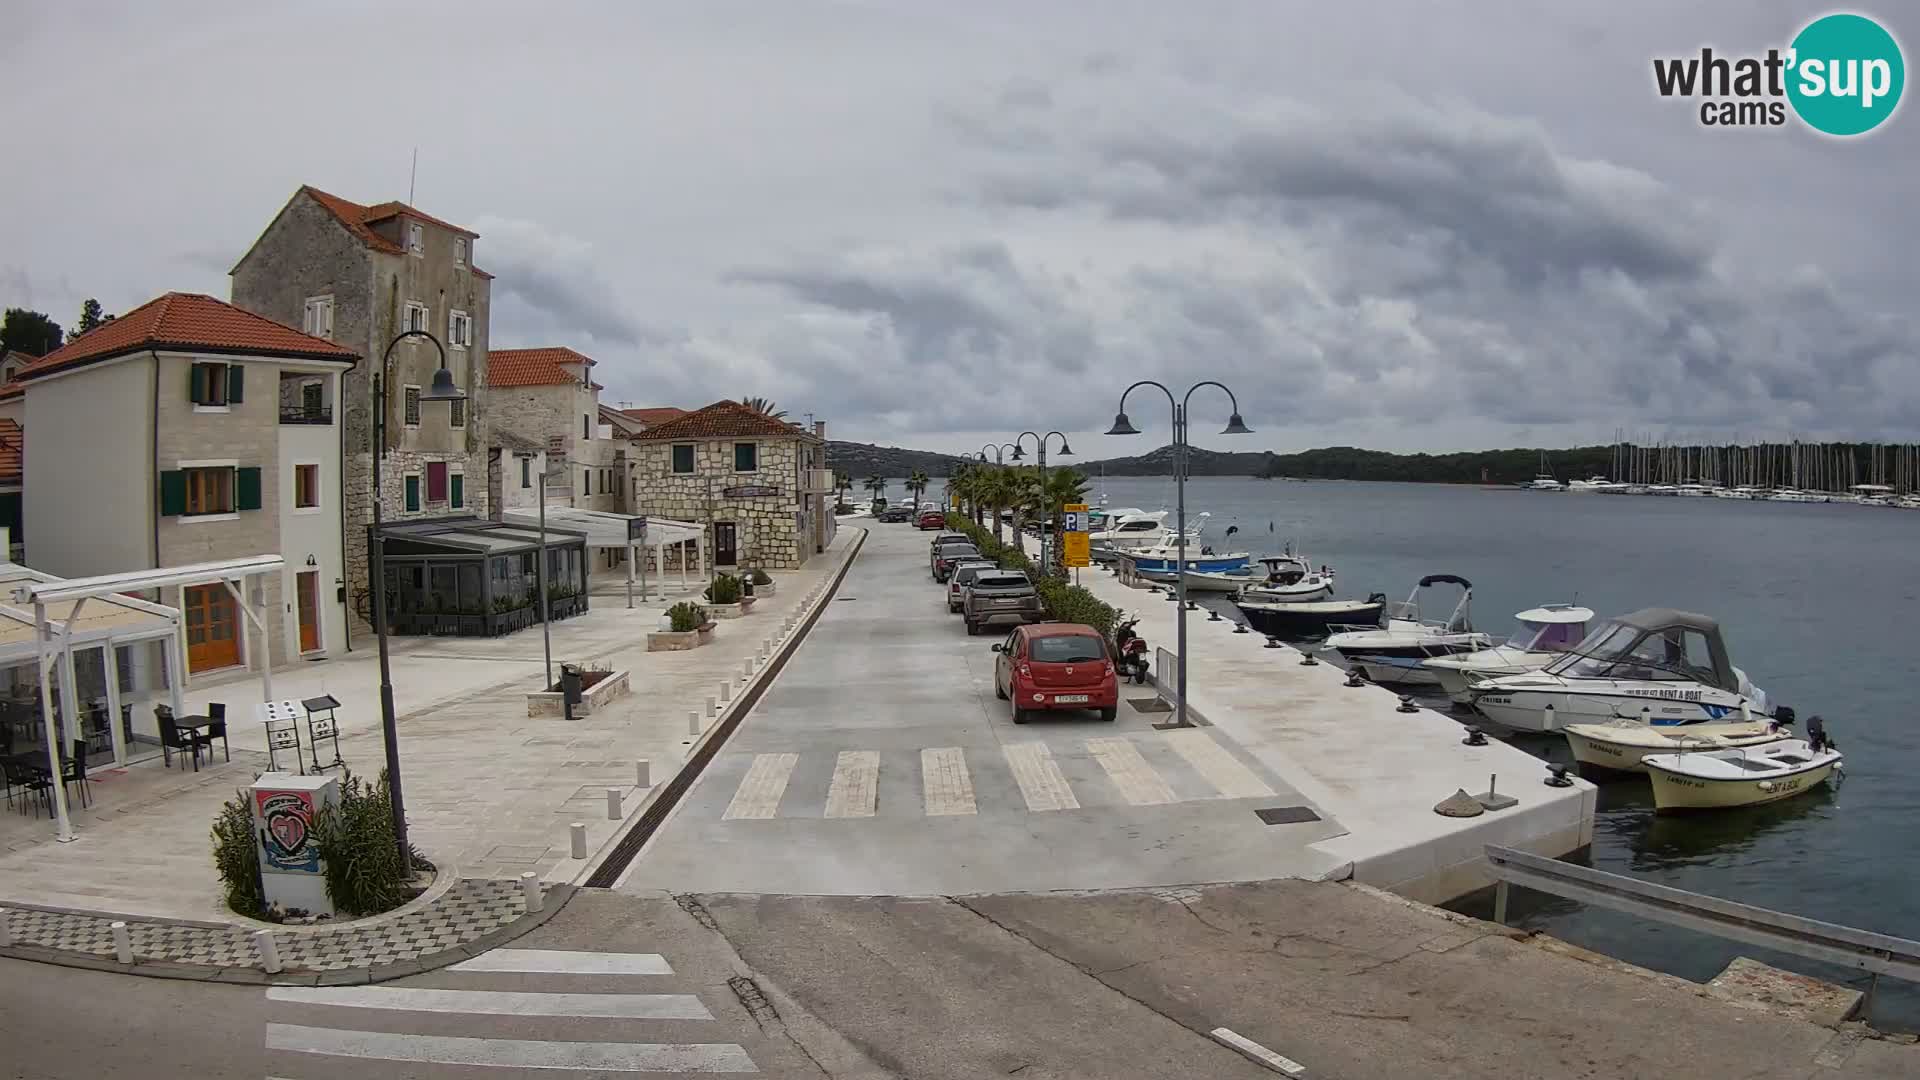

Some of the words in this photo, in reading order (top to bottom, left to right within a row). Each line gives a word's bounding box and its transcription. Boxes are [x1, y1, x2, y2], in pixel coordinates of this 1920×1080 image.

[1066, 514, 1077, 530] P
[1659, 689, 1678, 700] RENT
[1685, 690, 1703, 701] BOAT
